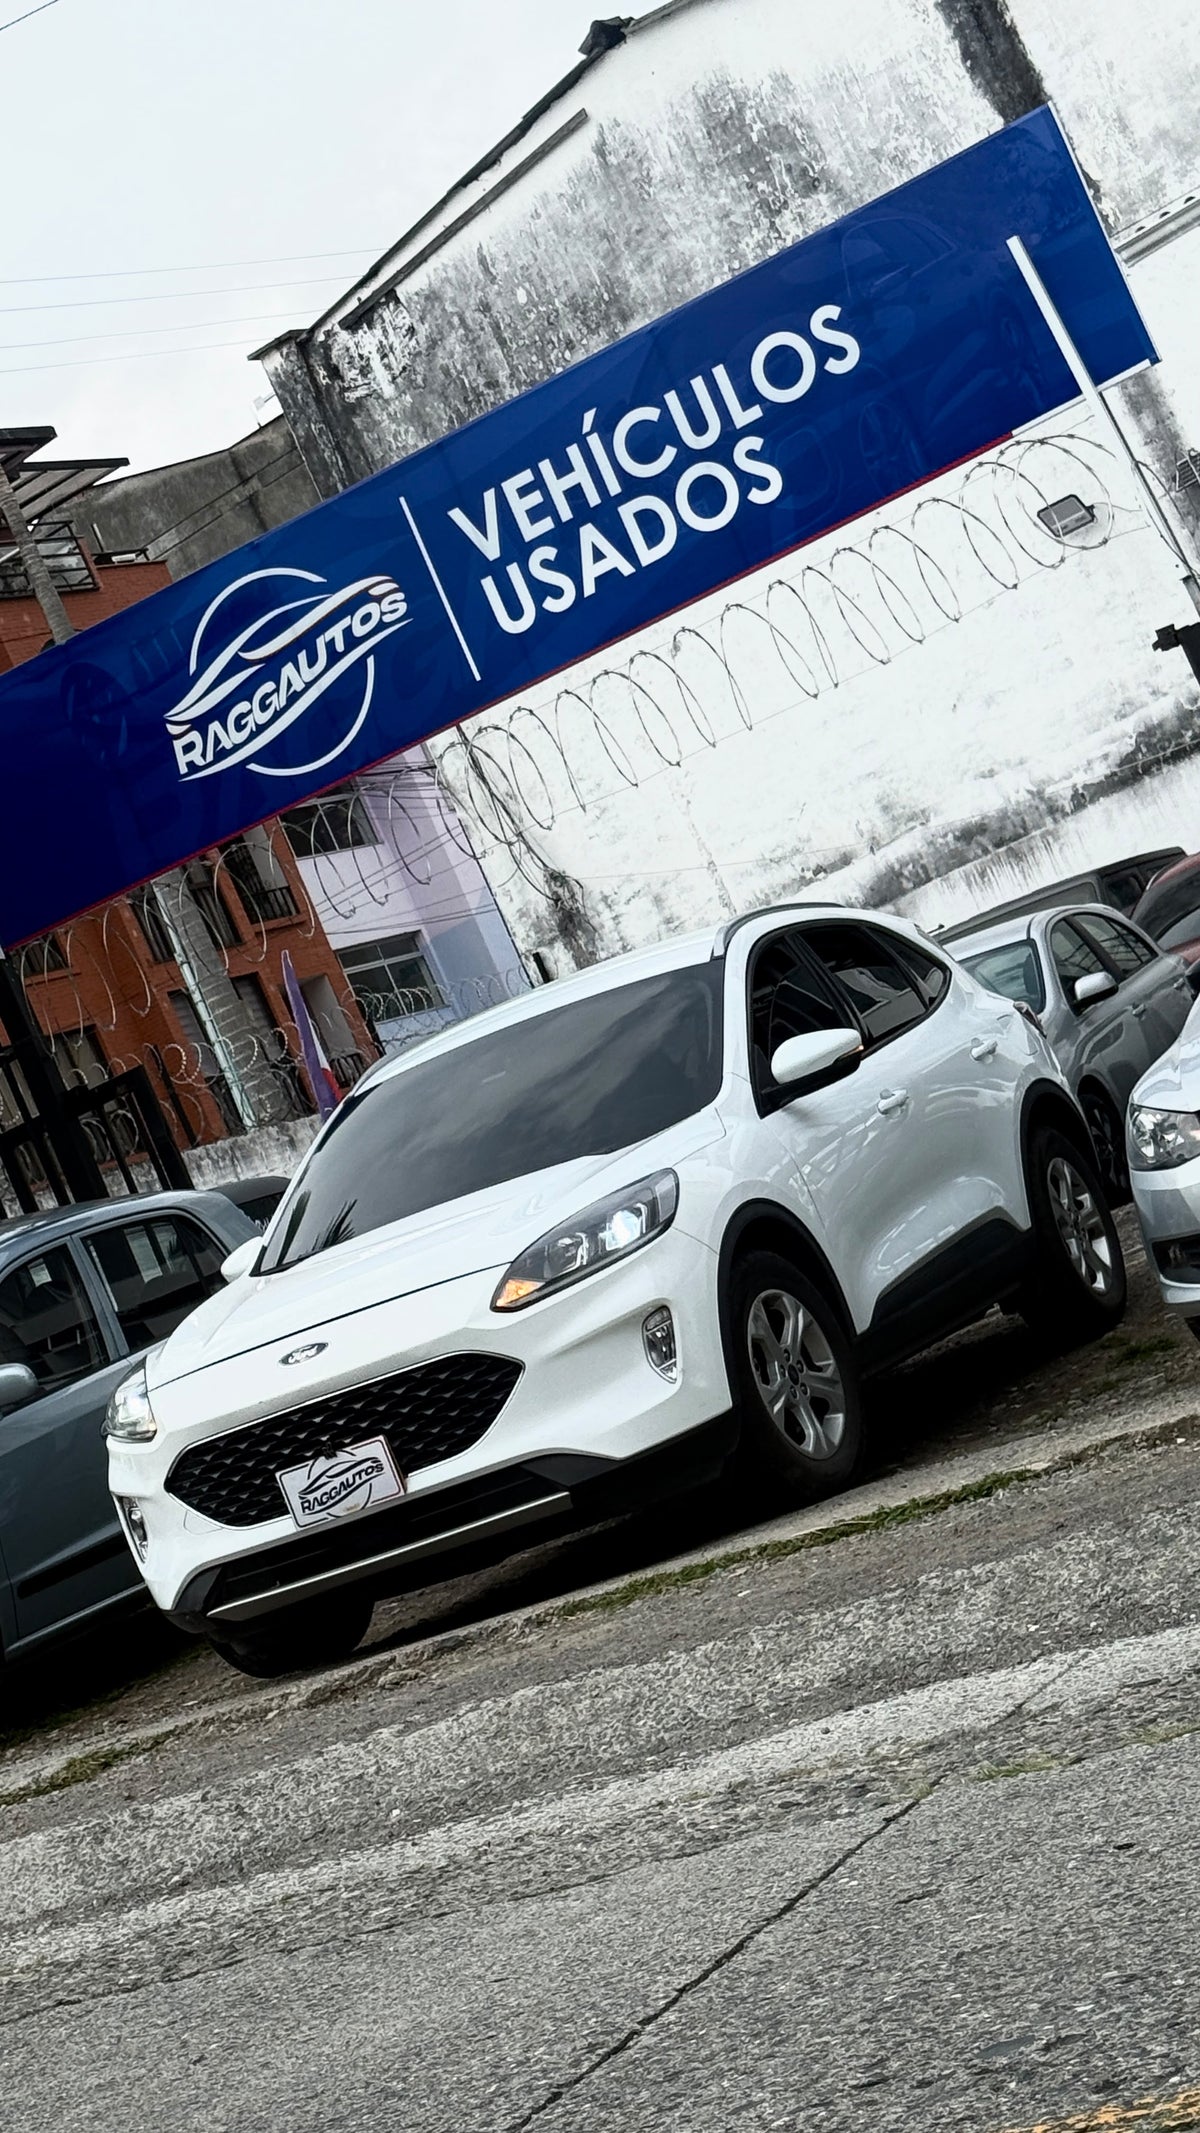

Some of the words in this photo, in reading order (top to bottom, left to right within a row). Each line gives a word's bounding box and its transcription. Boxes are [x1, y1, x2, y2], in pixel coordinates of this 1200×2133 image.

[447, 304, 861, 562] VEHÍCULOS
[480, 436, 784, 634] USADOS
[172, 591, 408, 775] RAGGAUTOS
[300, 1462, 385, 1514] RAGGAUTOS
